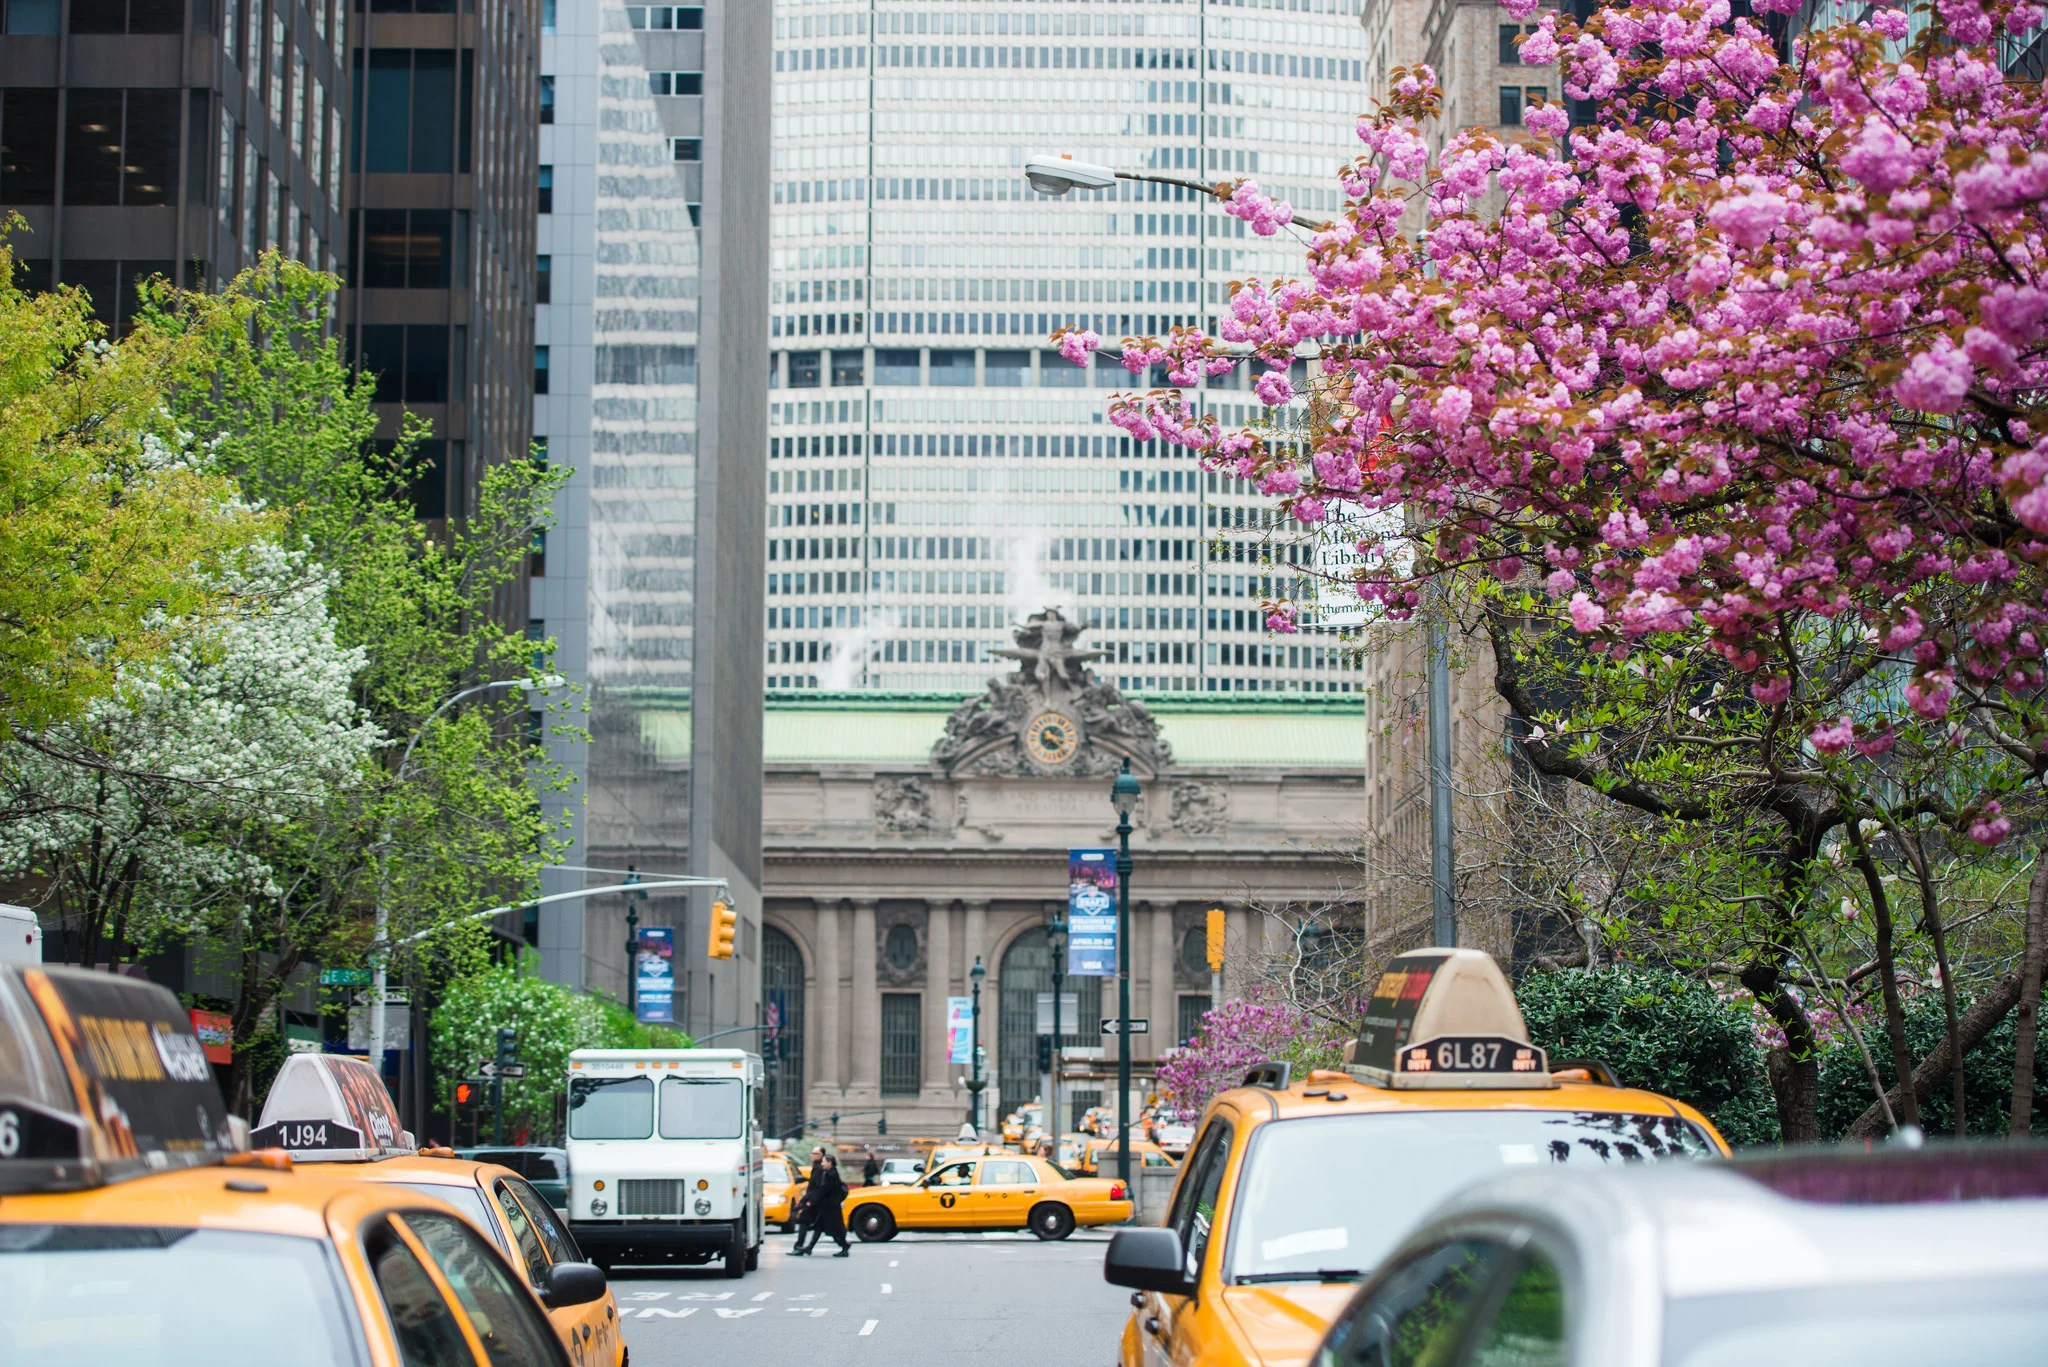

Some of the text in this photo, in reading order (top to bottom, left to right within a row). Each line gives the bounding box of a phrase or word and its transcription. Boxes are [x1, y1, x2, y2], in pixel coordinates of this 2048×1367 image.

[1320, 529, 1392, 545] Mon
[1322, 549, 1388, 566] Librar
[331, 970, 338, 982] E
[1437, 1042, 1501, 1069] 6L87
[278, 1124, 327, 1146] 1J94
